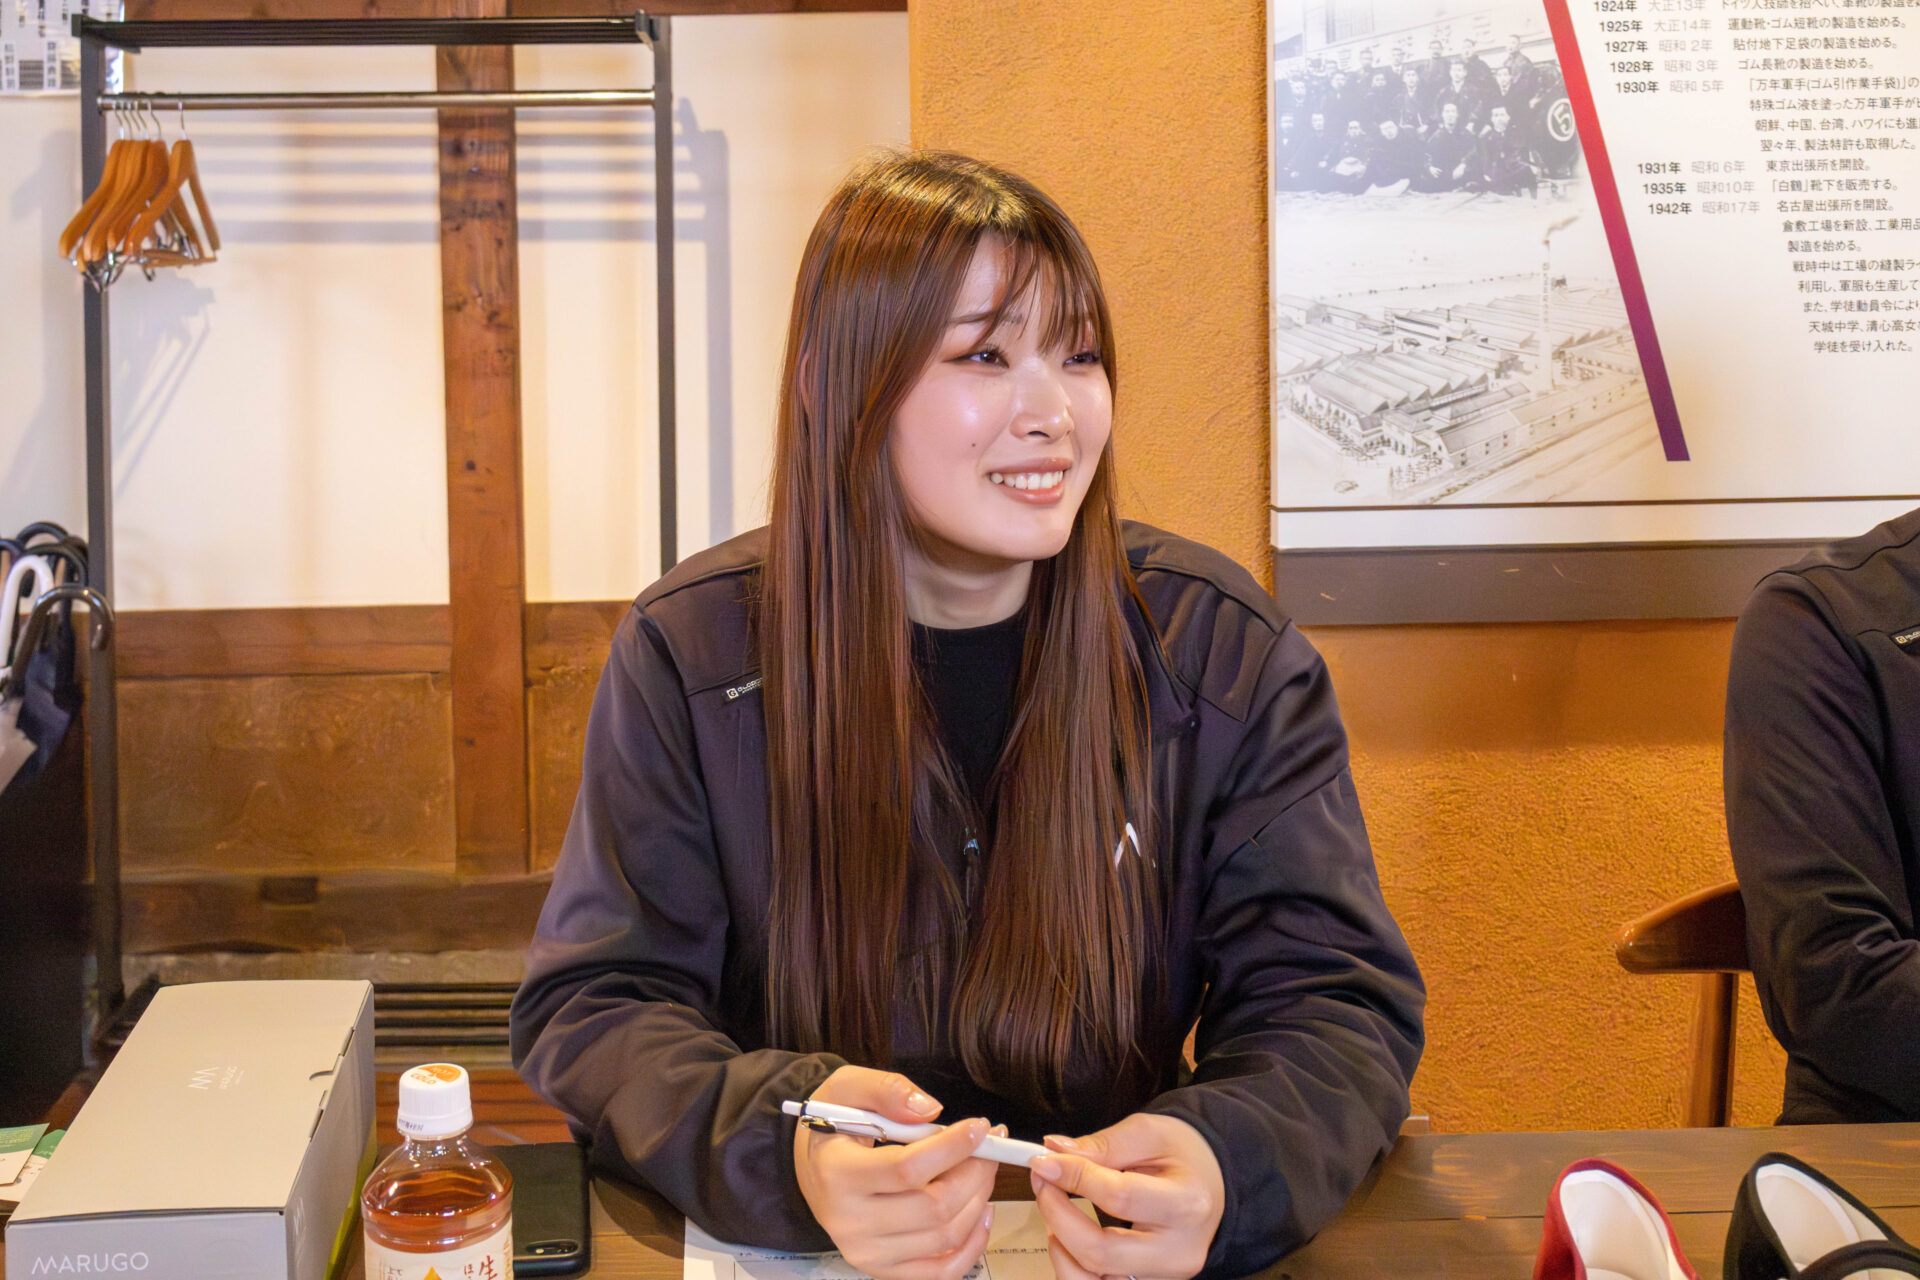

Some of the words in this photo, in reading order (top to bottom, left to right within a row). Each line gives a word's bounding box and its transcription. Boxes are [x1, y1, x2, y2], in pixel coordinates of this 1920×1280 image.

[1594, 0, 1637, 12] 1924年
[1600, 20, 1643, 32] 1925年
[1654, 19, 1711, 32] 大正14年
[1605, 40, 1648, 52] 1927年
[1610, 60, 1654, 72] 1928年
[1616, 81, 1659, 93] 1930年
[1638, 162, 1681, 174] 1931年
[1643, 182, 1687, 194] 1935年
[1697, 181, 1755, 194] 昭和10年
[1648, 202, 1692, 214] 1942年
[1702, 201, 1760, 214] 昭和17年
[31, 1252, 149, 1275] MARUGO
